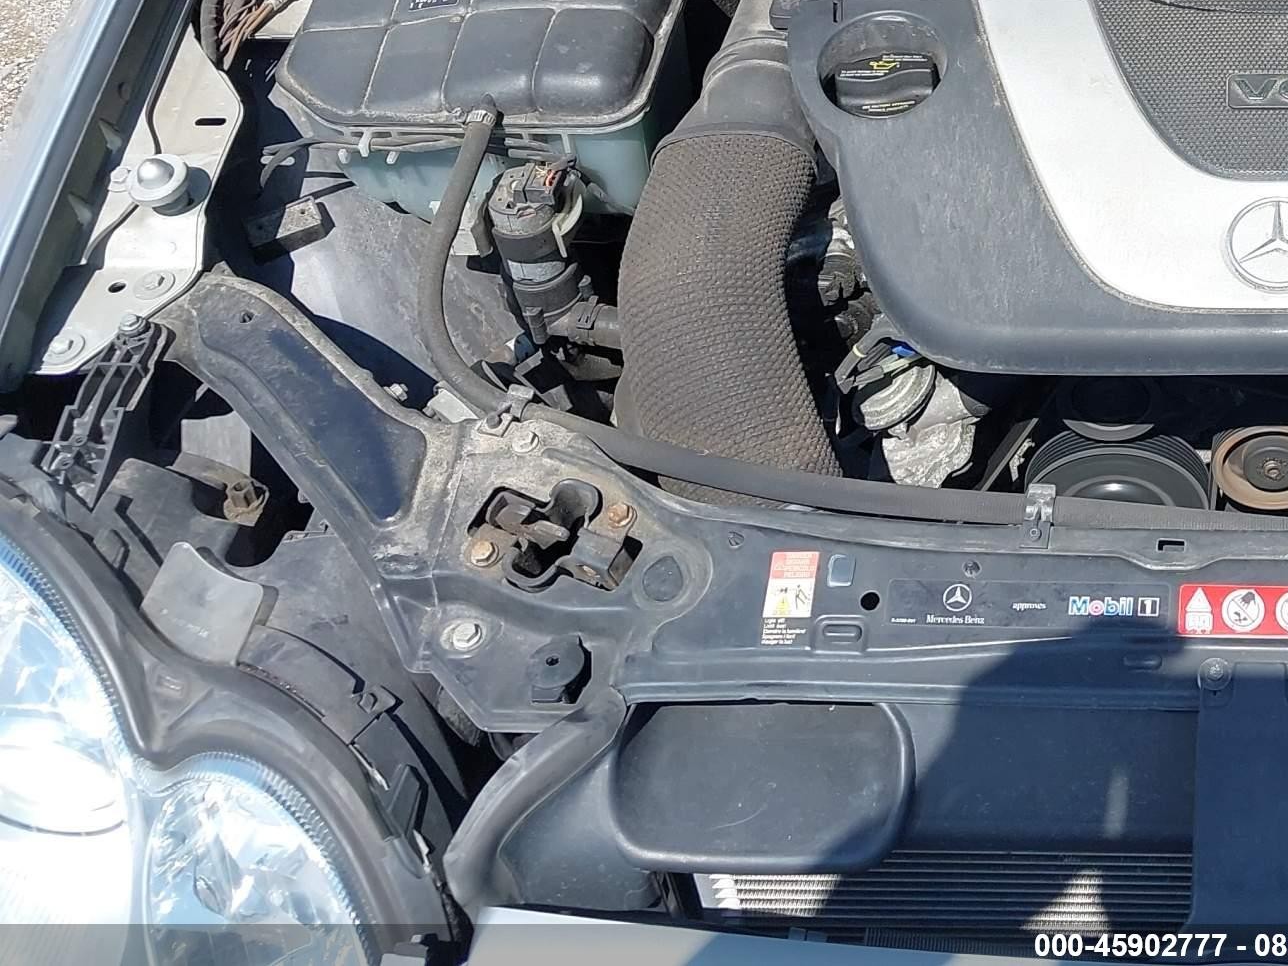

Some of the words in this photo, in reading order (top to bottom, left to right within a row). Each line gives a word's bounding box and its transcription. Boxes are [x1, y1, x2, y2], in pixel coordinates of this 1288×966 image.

[1012, 602, 1047, 611] approves
[1068, 596, 1133, 616] Mobil
[926, 614, 963, 624] Mercedes
